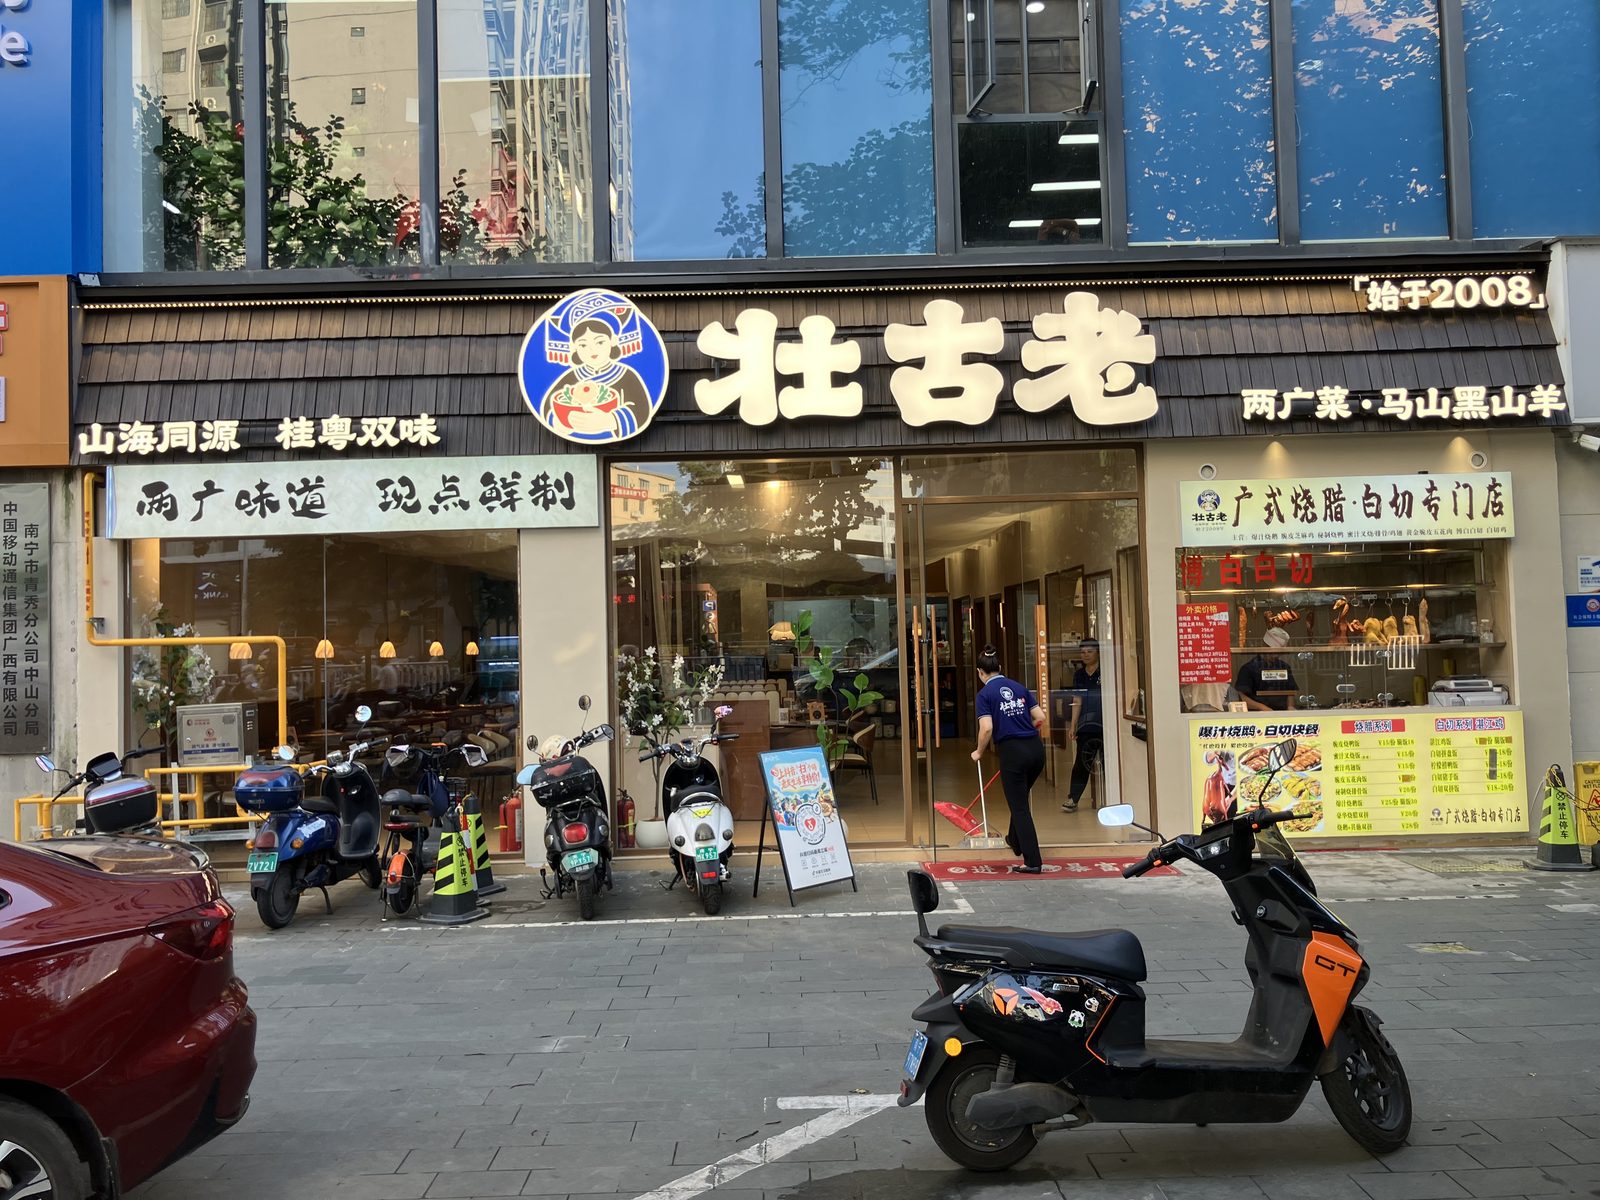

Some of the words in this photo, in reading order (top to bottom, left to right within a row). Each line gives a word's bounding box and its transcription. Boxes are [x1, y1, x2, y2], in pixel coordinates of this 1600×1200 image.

[694, 291, 1158, 427] 壮古老
[1241, 384, 1566, 420] 两广菜·马山黑山羊
[78, 418, 241, 455] 山海同源
[276, 413, 441, 451] 桂粤双味
[136, 475, 331, 521] 两广味道
[376, 471, 575, 513] 现点鲜制
[1192, 512, 1227, 522] 壮古老
[2, 501, 18, 737] 中国移动通信集团广西有限公司
[1186, 606, 1217, 614] 外卖价格
[24, 524, 40, 737] 南宁市青秀分公司中山分局
[1354, 720, 1392, 733] 烧腊系列
[1436, 719, 1473, 731] 白切系列
[1558, 802, 1569, 839] 禁止停车
[1315, 954, 1356, 977] GT
